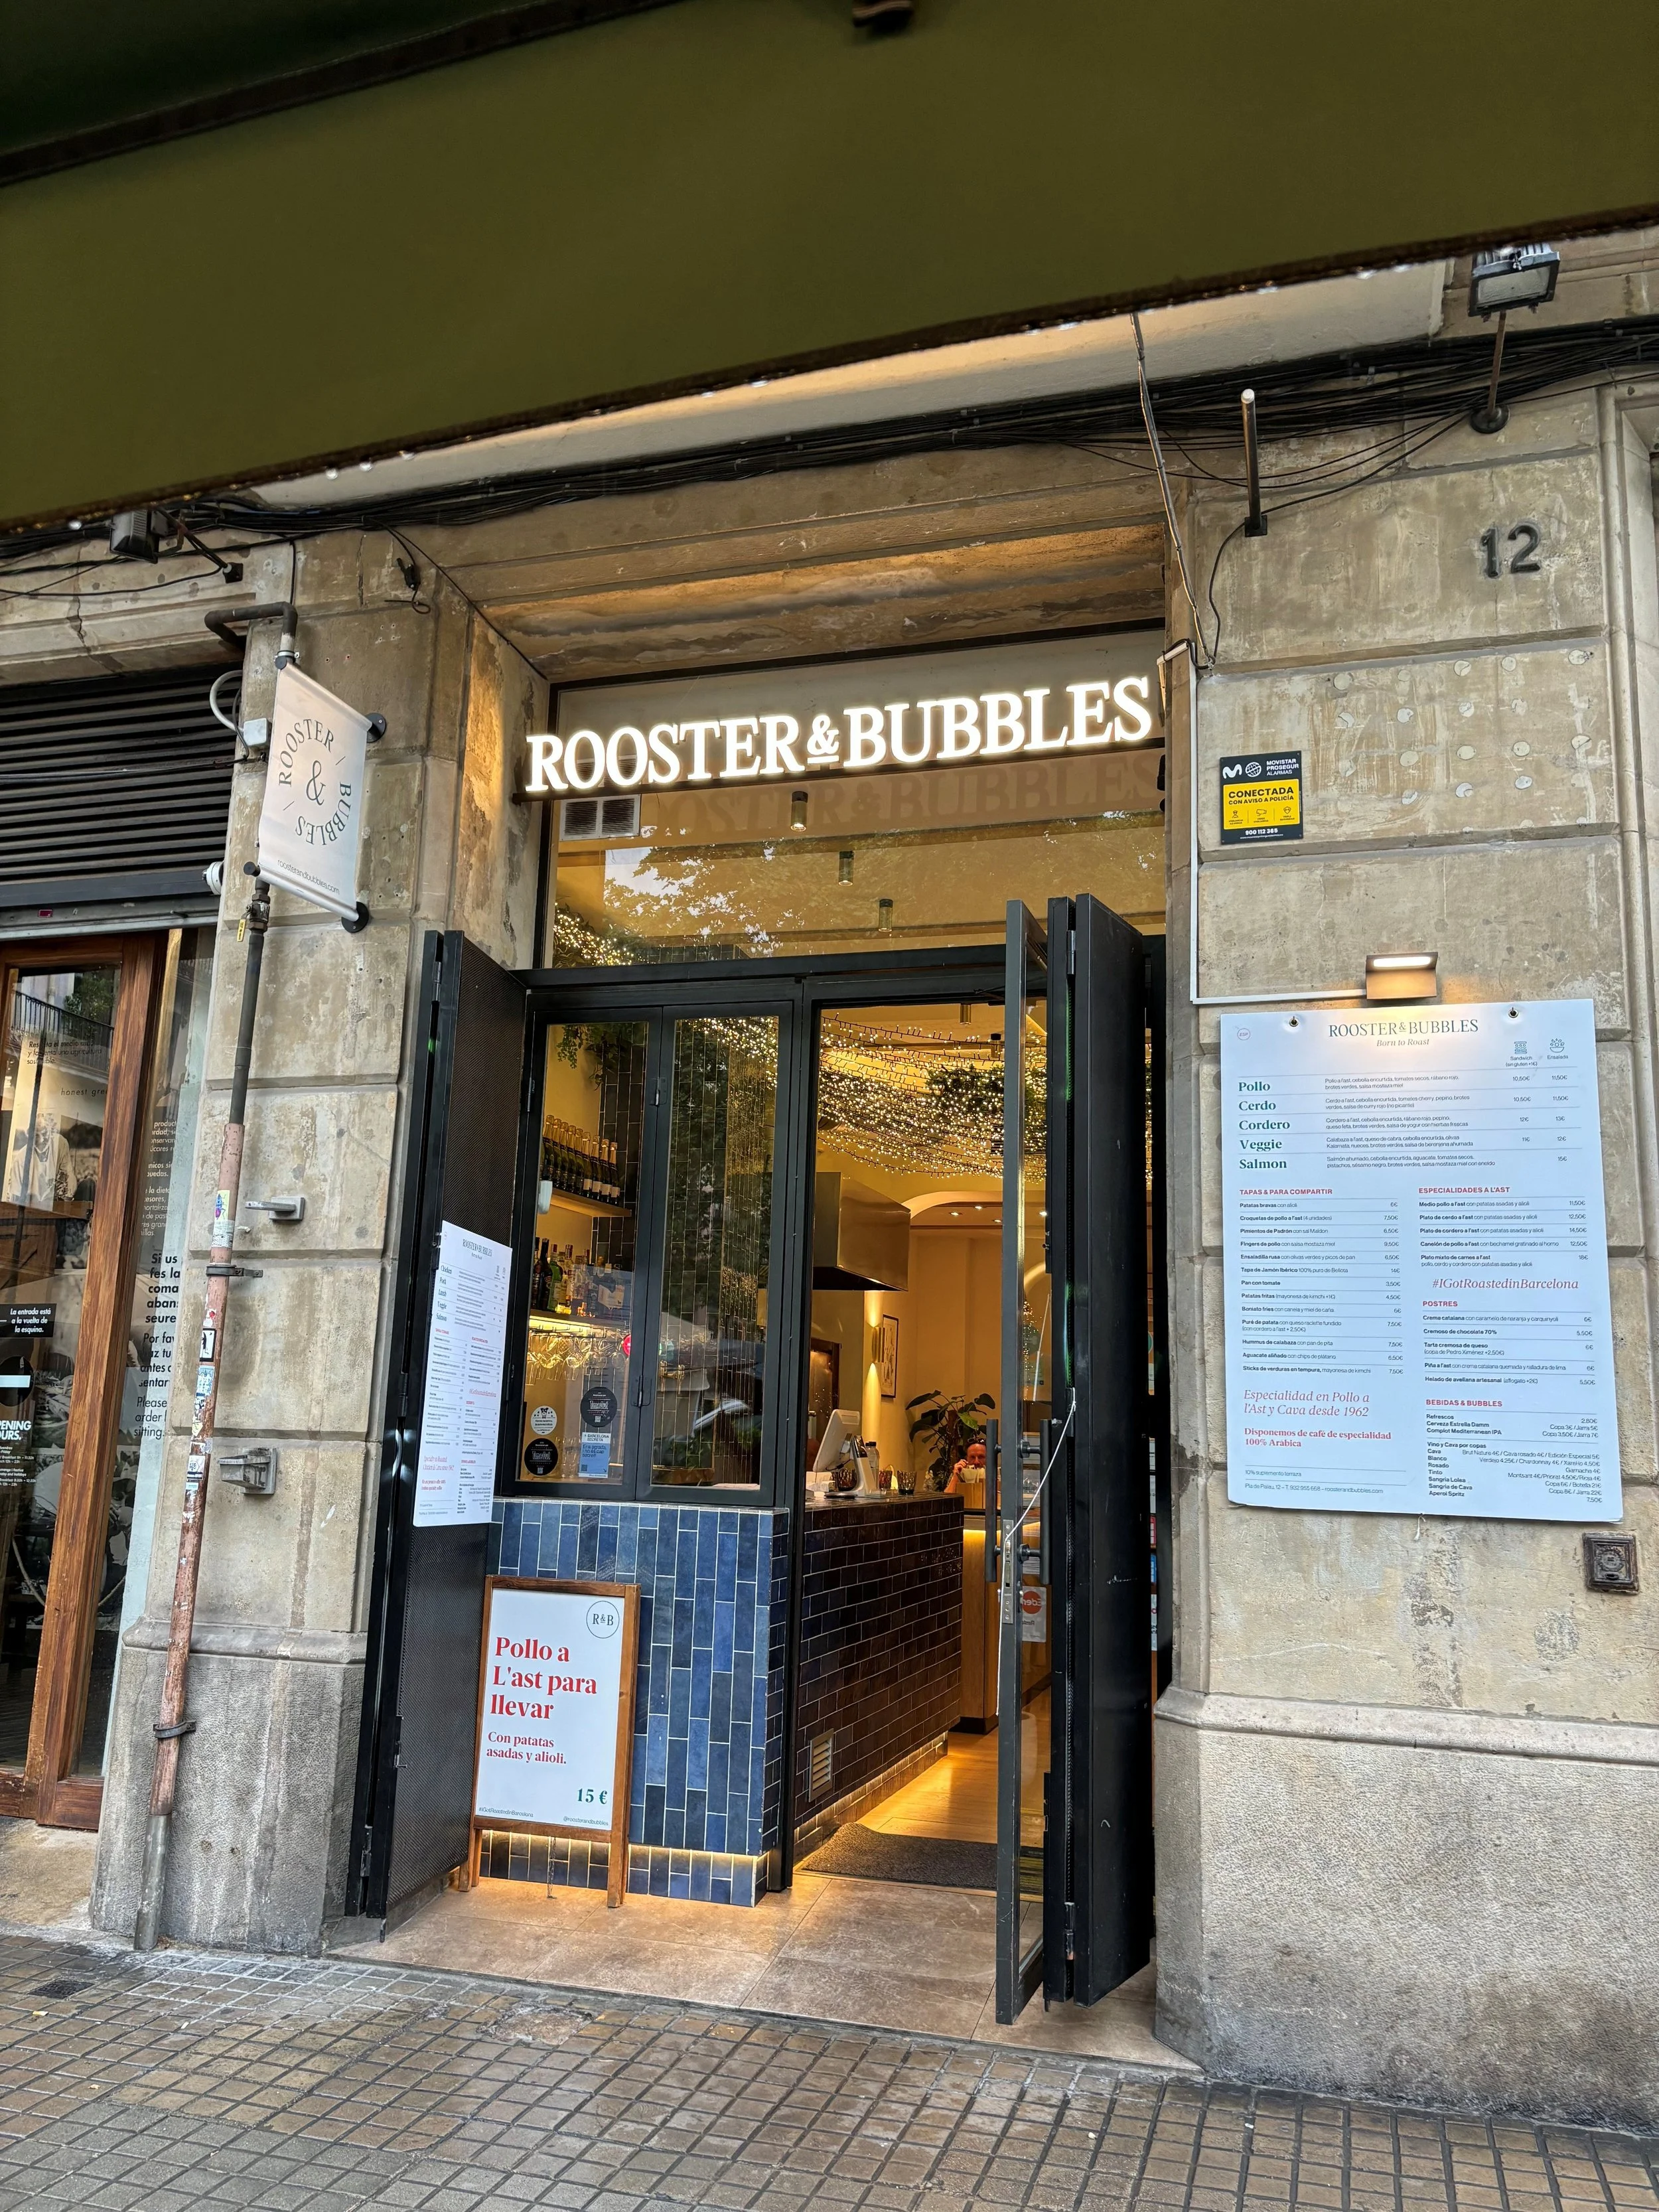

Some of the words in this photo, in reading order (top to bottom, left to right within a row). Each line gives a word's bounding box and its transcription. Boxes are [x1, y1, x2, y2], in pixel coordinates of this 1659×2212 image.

[1480, 524, 1541, 577] 12
[278, 719, 334, 787] ROOSTER
[305, 759, 326, 806] &
[1228, 786, 1294, 798] CONECTADA
[295, 780, 351, 846] BUBBLES
[277, 859, 340, 895] roosterandbubbles.com
[1238, 1082, 1270, 1092] Pollo
[1238, 1100, 1276, 1111] Cerdo
[1239, 1120, 1291, 1130] Cordero
[1240, 1140, 1283, 1151] Veggie
[1240, 1159, 1287, 1169] Salmon
[151, 1254, 161, 1264] Si
[165, 1255, 177, 1264] us
[150, 1267, 166, 1279] fes
[170, 1267, 180, 1278] la
[148, 1284, 179, 1293] coma
[145, 1314, 177, 1323] seure
[21, 1326, 44, 1335] esquina.
[143, 1333, 159, 1343] Por
[162, 1349, 171, 1358] tu
[140, 1364, 166, 1372] antes
[137, 1396, 167, 1408] Please
[1244, 1390, 1313, 1402] Especialidad
[1316, 1393, 1329, 1402] en
[1332, 1392, 1360, 1402] Pollo
[135, 1410, 162, 1422] order
[1244, 1404, 1265, 1414] l'Ast
[1267, 1406, 1274, 1416] y
[1277, 1404, 1306, 1415] Cava
[1309, 1406, 1340, 1416] desde
[1344, 1406, 1369, 1417] 1962
[0, 1420, 32, 1431] ENING
[0, 1430, 22, 1440] URS.
[134, 1426, 165, 1440] sitting.
[1244, 1428, 1296, 1438] Disponemos
[1339, 1431, 1391, 1440] especialidad
[495, 1637, 553, 1660] Pollo
[558, 1647, 570, 1662] a
[493, 1665, 547, 1688] L'ast
[547, 1675, 597, 1696] para
[490, 1694, 555, 1720] llevar
[488, 1732, 511, 1743] Con
[514, 1734, 555, 1748] patatas
[486, 1747, 524, 1760] asadas
[526, 1751, 533, 1763] y
[534, 1751, 567, 1765] alioli.
[577, 1787, 595, 1804] 15
[599, 1789, 608, 1805] €
